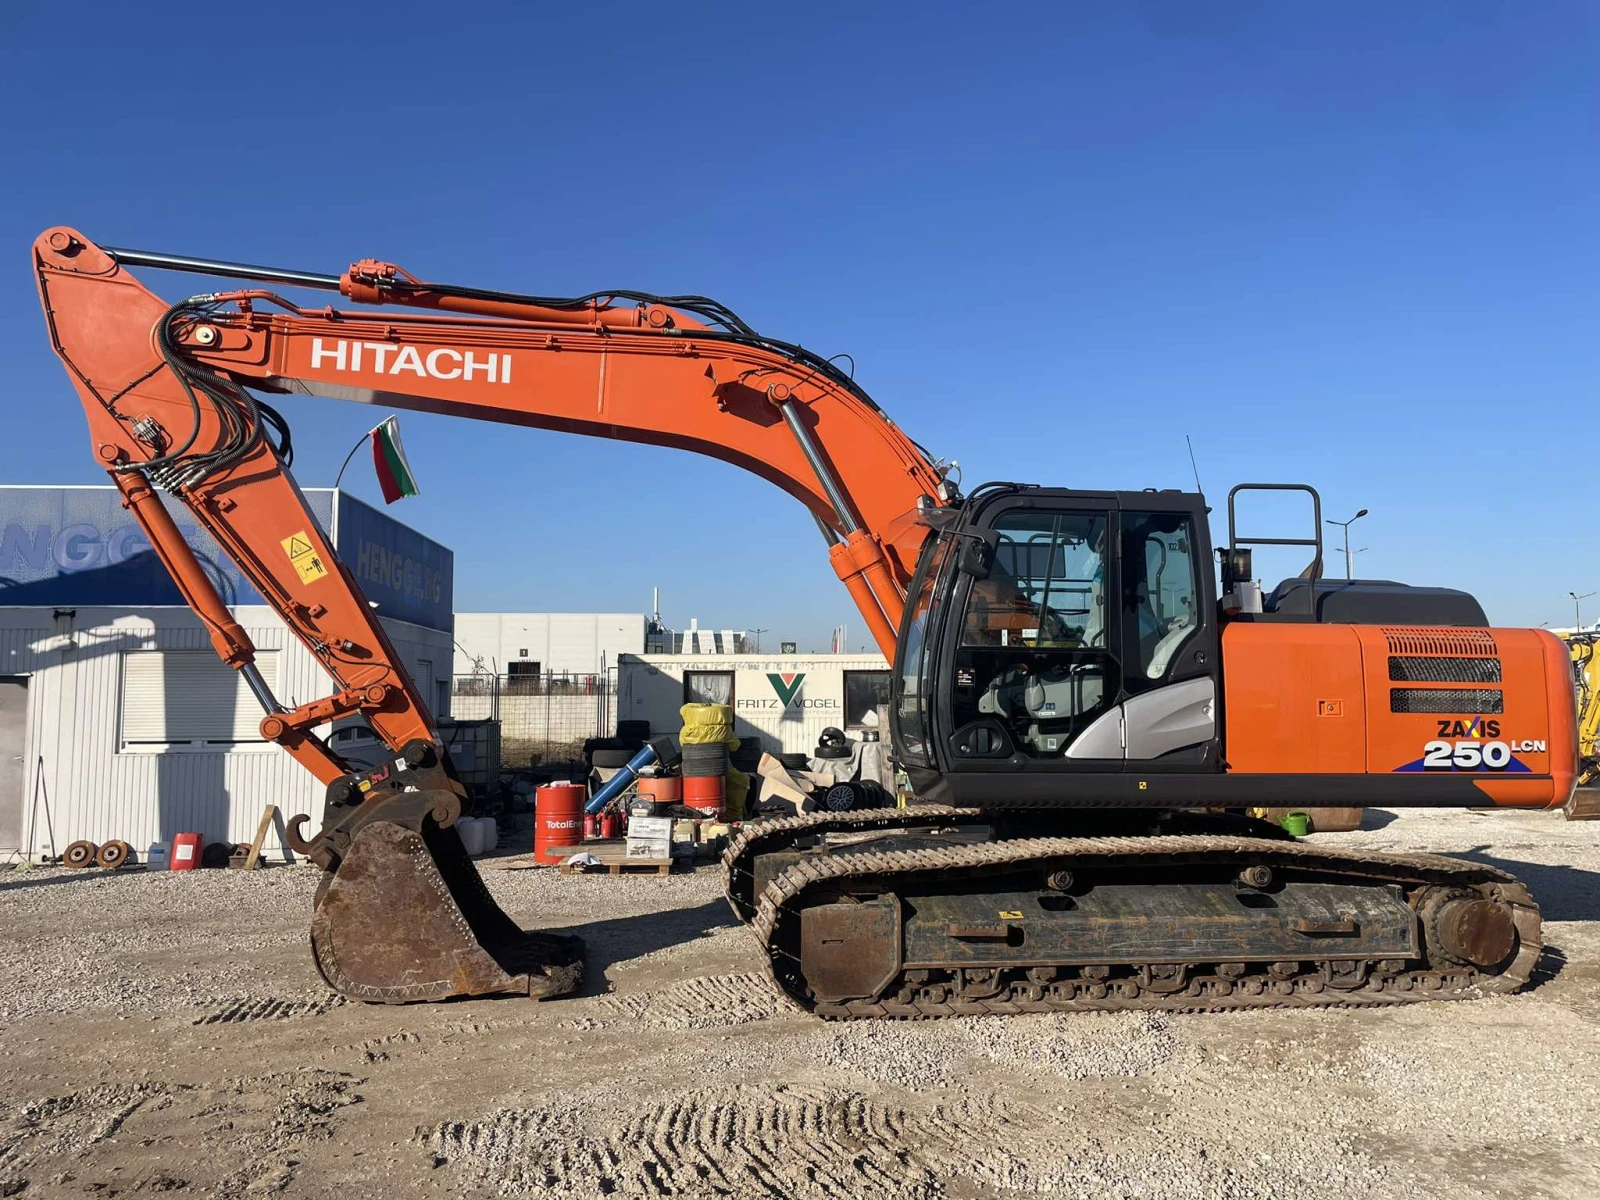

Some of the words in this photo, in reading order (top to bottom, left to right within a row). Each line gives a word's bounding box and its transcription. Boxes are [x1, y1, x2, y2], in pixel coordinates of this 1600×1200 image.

[311, 338, 511, 384] HITACHI
[737, 699, 778, 708] FRITZ
[793, 699, 841, 708] VOGEL
[1437, 716, 1500, 738] ZAXIS
[1423, 740, 1511, 769] 250
[1511, 740, 1546, 752] LCN
